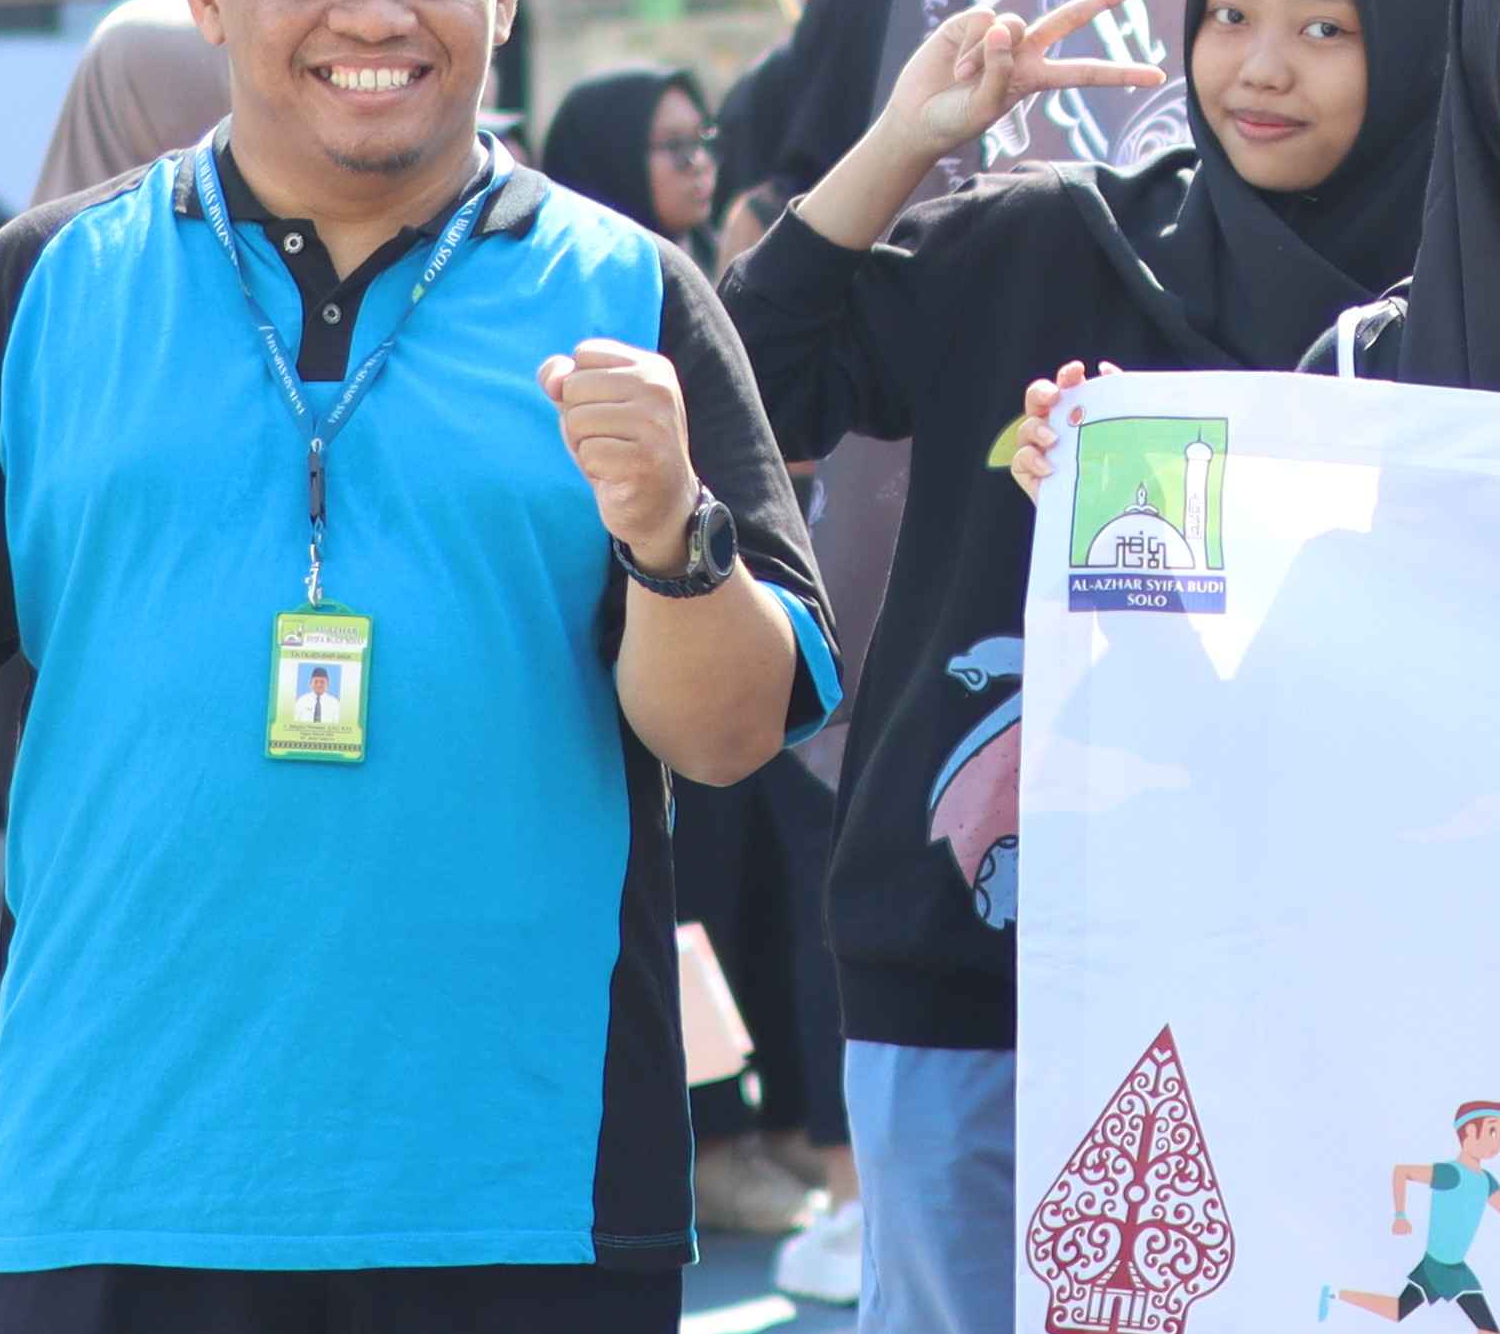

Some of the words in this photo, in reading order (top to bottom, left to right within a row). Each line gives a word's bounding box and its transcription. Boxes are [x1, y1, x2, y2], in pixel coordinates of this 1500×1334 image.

[1071, 578, 1142, 591] AL-AZHAR
[1147, 579, 1184, 593] SYIFA
[1188, 580, 1224, 594] BUDI
[1127, 594, 1168, 607] SOLO
